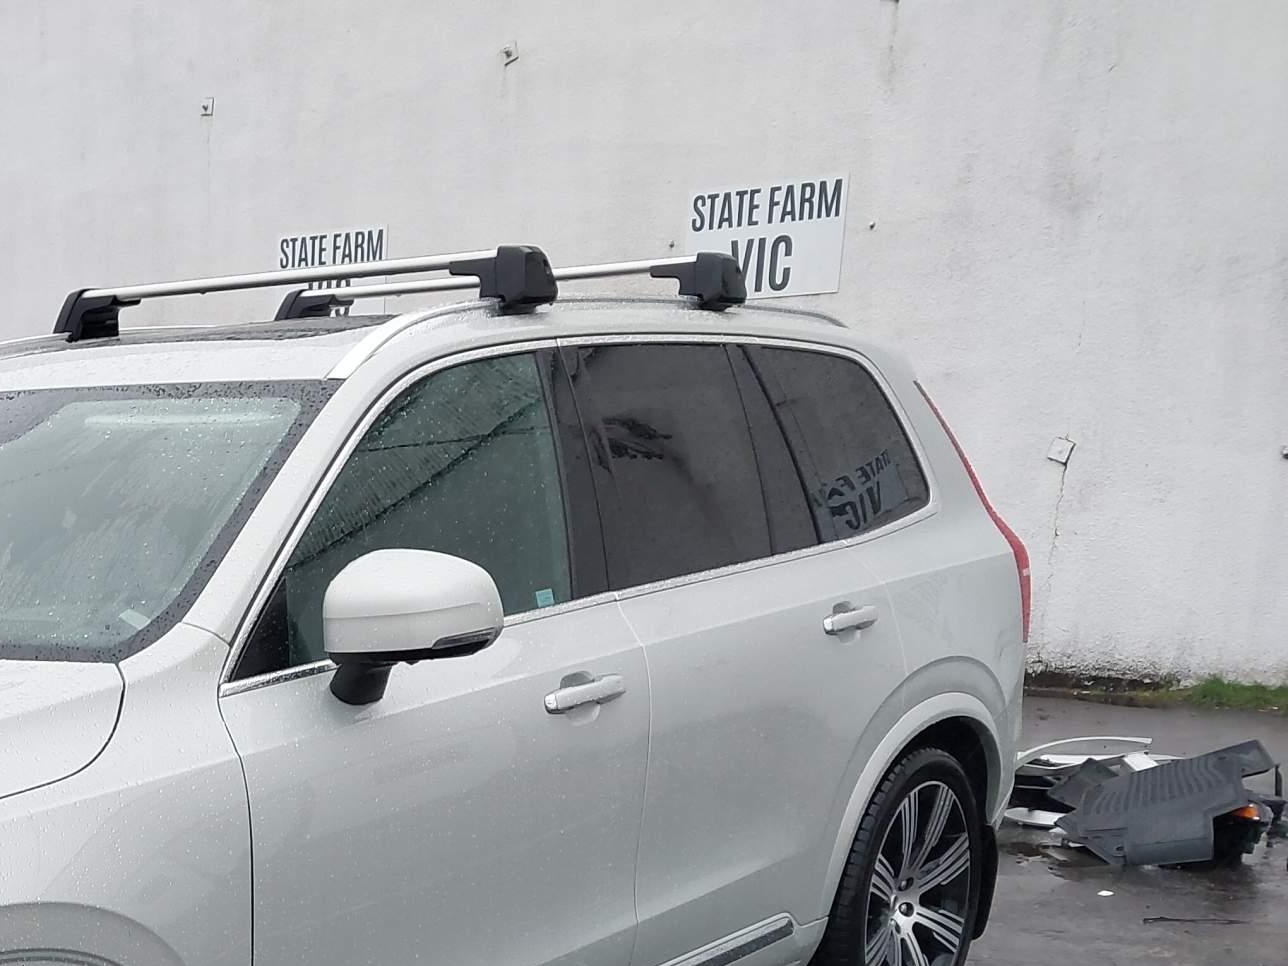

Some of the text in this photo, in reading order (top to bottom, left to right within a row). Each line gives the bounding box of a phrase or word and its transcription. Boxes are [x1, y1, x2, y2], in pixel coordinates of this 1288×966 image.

[691, 178, 843, 232] STATE FARM
[280, 229, 383, 269] STATE FARM
[731, 234, 793, 292] VIC
